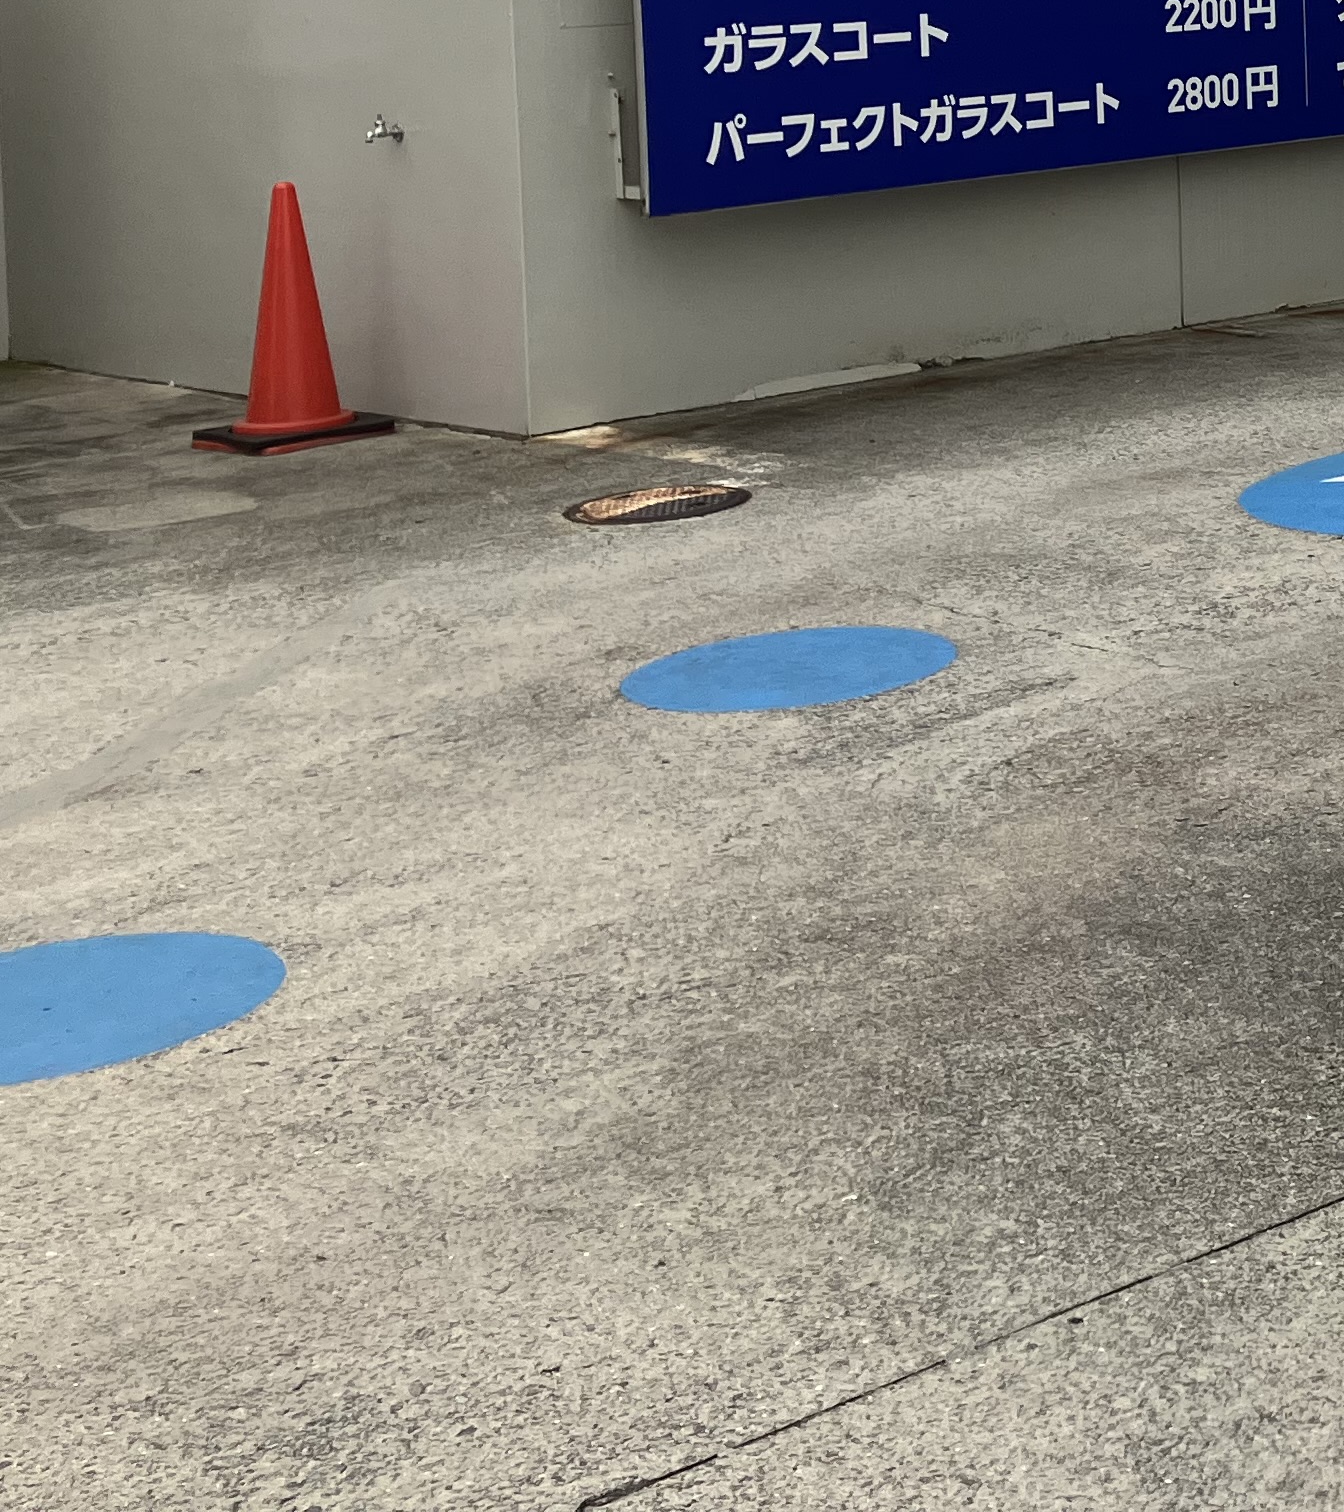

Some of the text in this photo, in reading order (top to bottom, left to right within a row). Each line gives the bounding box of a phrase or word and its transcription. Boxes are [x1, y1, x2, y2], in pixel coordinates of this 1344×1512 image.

[704, 13, 949, 74] ガラスコート
[705, 65, 1278, 165] パーフェクトガラスコート 2800円
